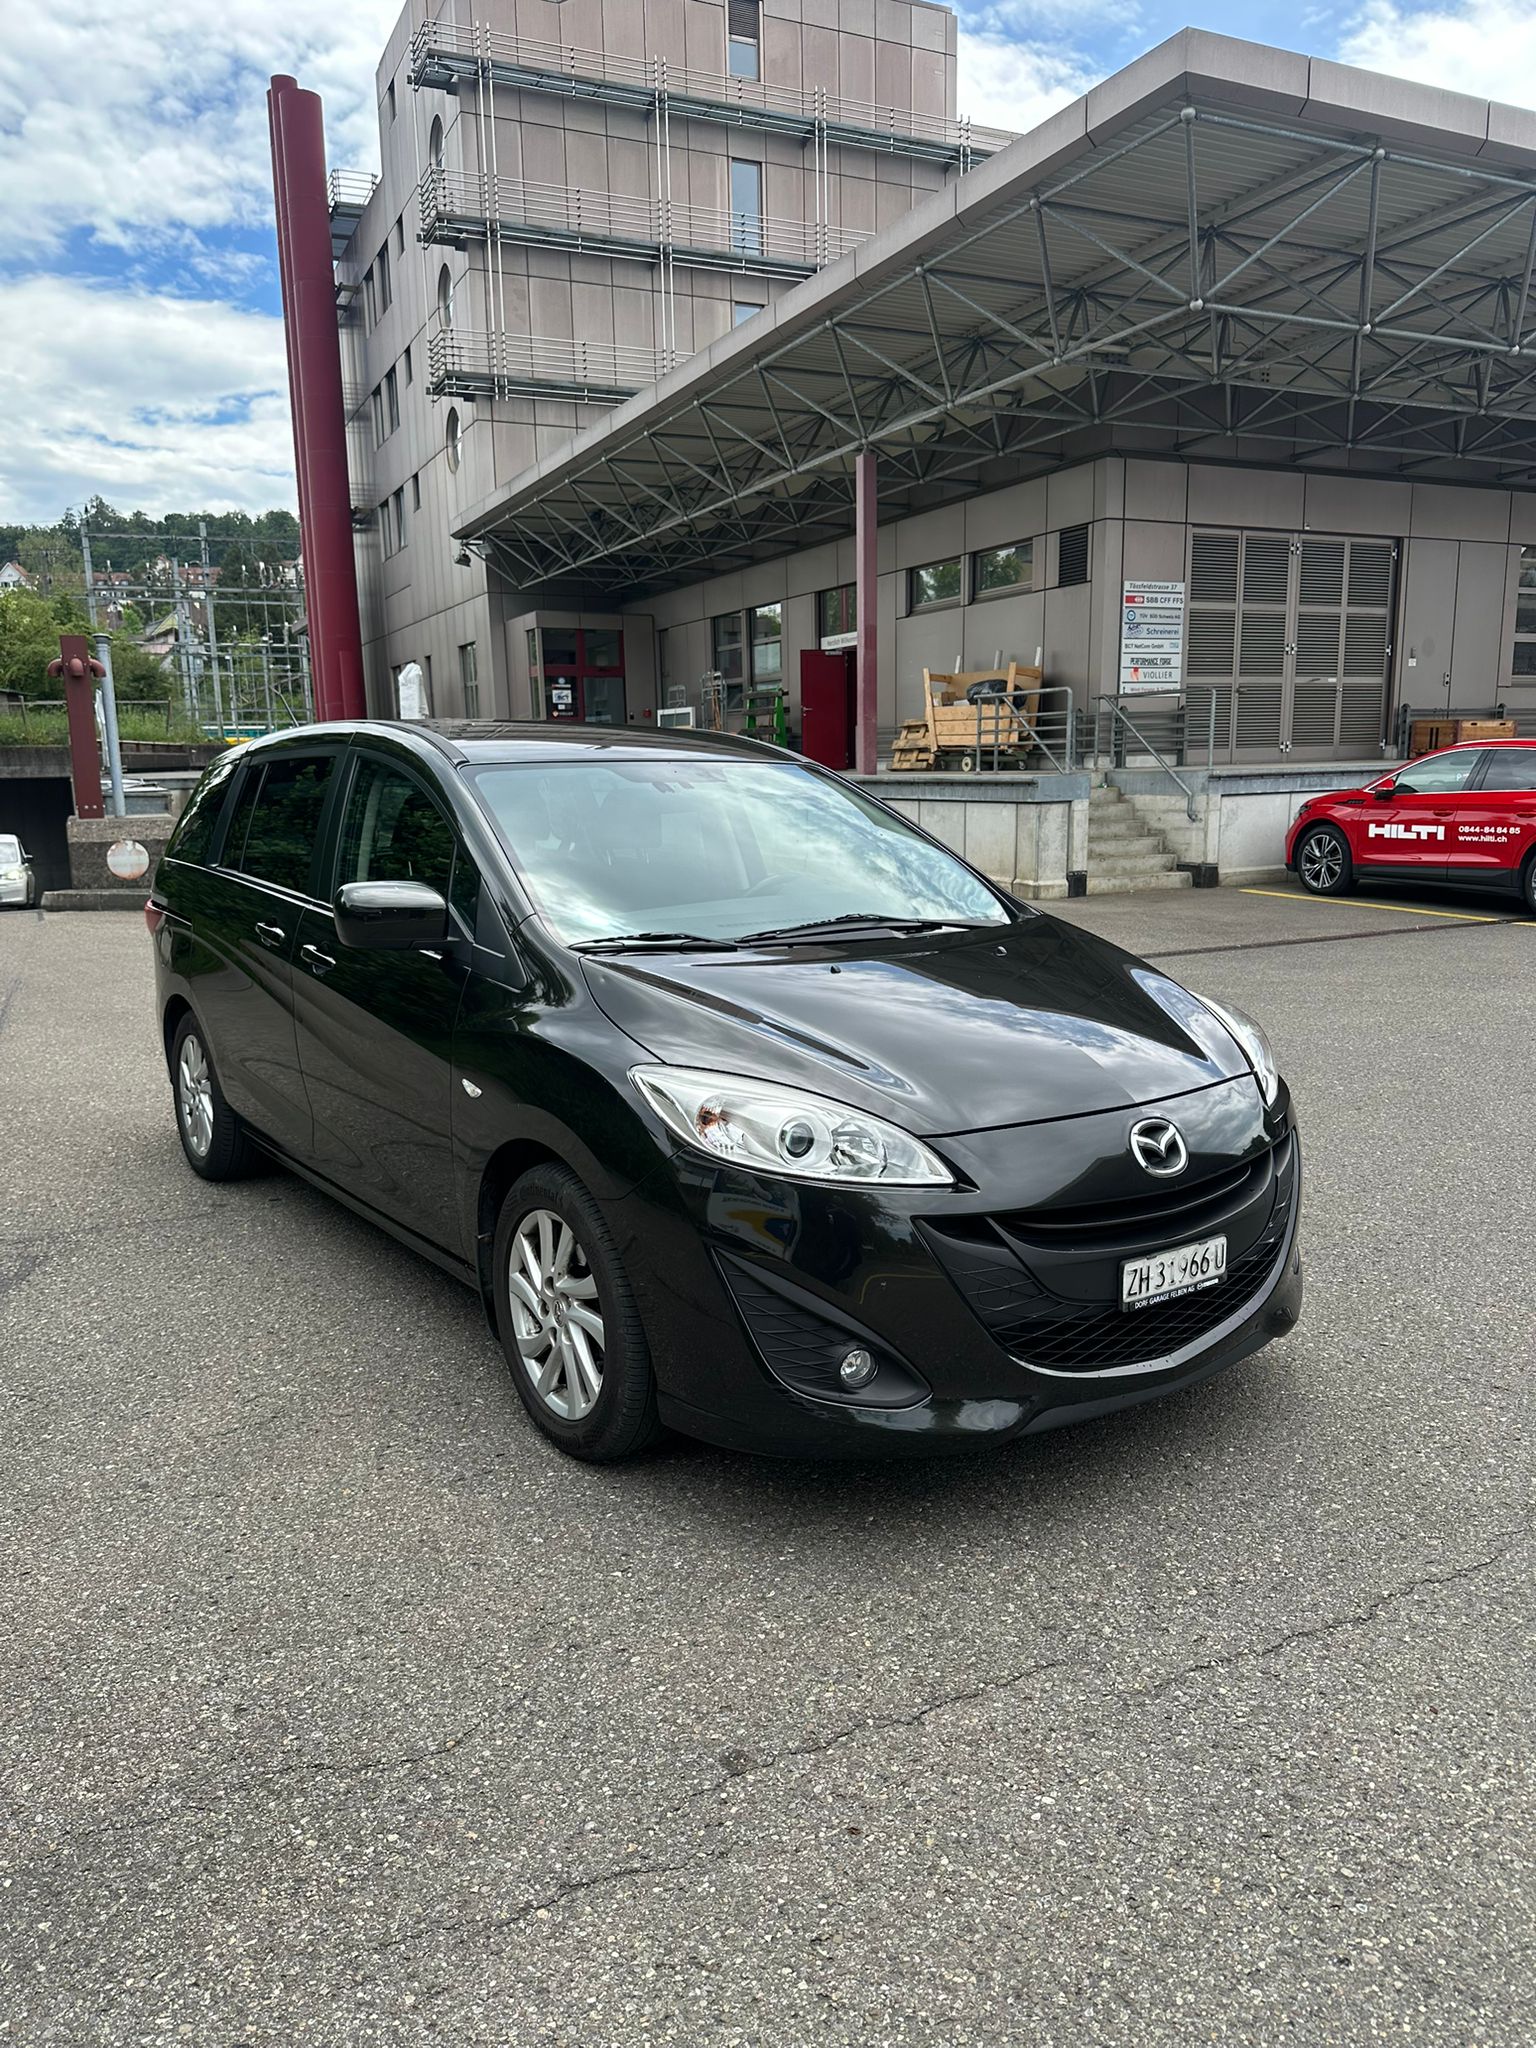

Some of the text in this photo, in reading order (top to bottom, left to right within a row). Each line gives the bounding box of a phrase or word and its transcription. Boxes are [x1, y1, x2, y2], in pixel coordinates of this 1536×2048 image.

[1172, 597, 1184, 605] FFS
[1142, 671, 1173, 680] VIOLLIER
[1368, 823, 1445, 840] HILTI
[1509, 827, 1521, 835] 85
[1457, 835, 1508, 843] www.hilti.ch
[1149, 1293, 1170, 1305] GARAGE
